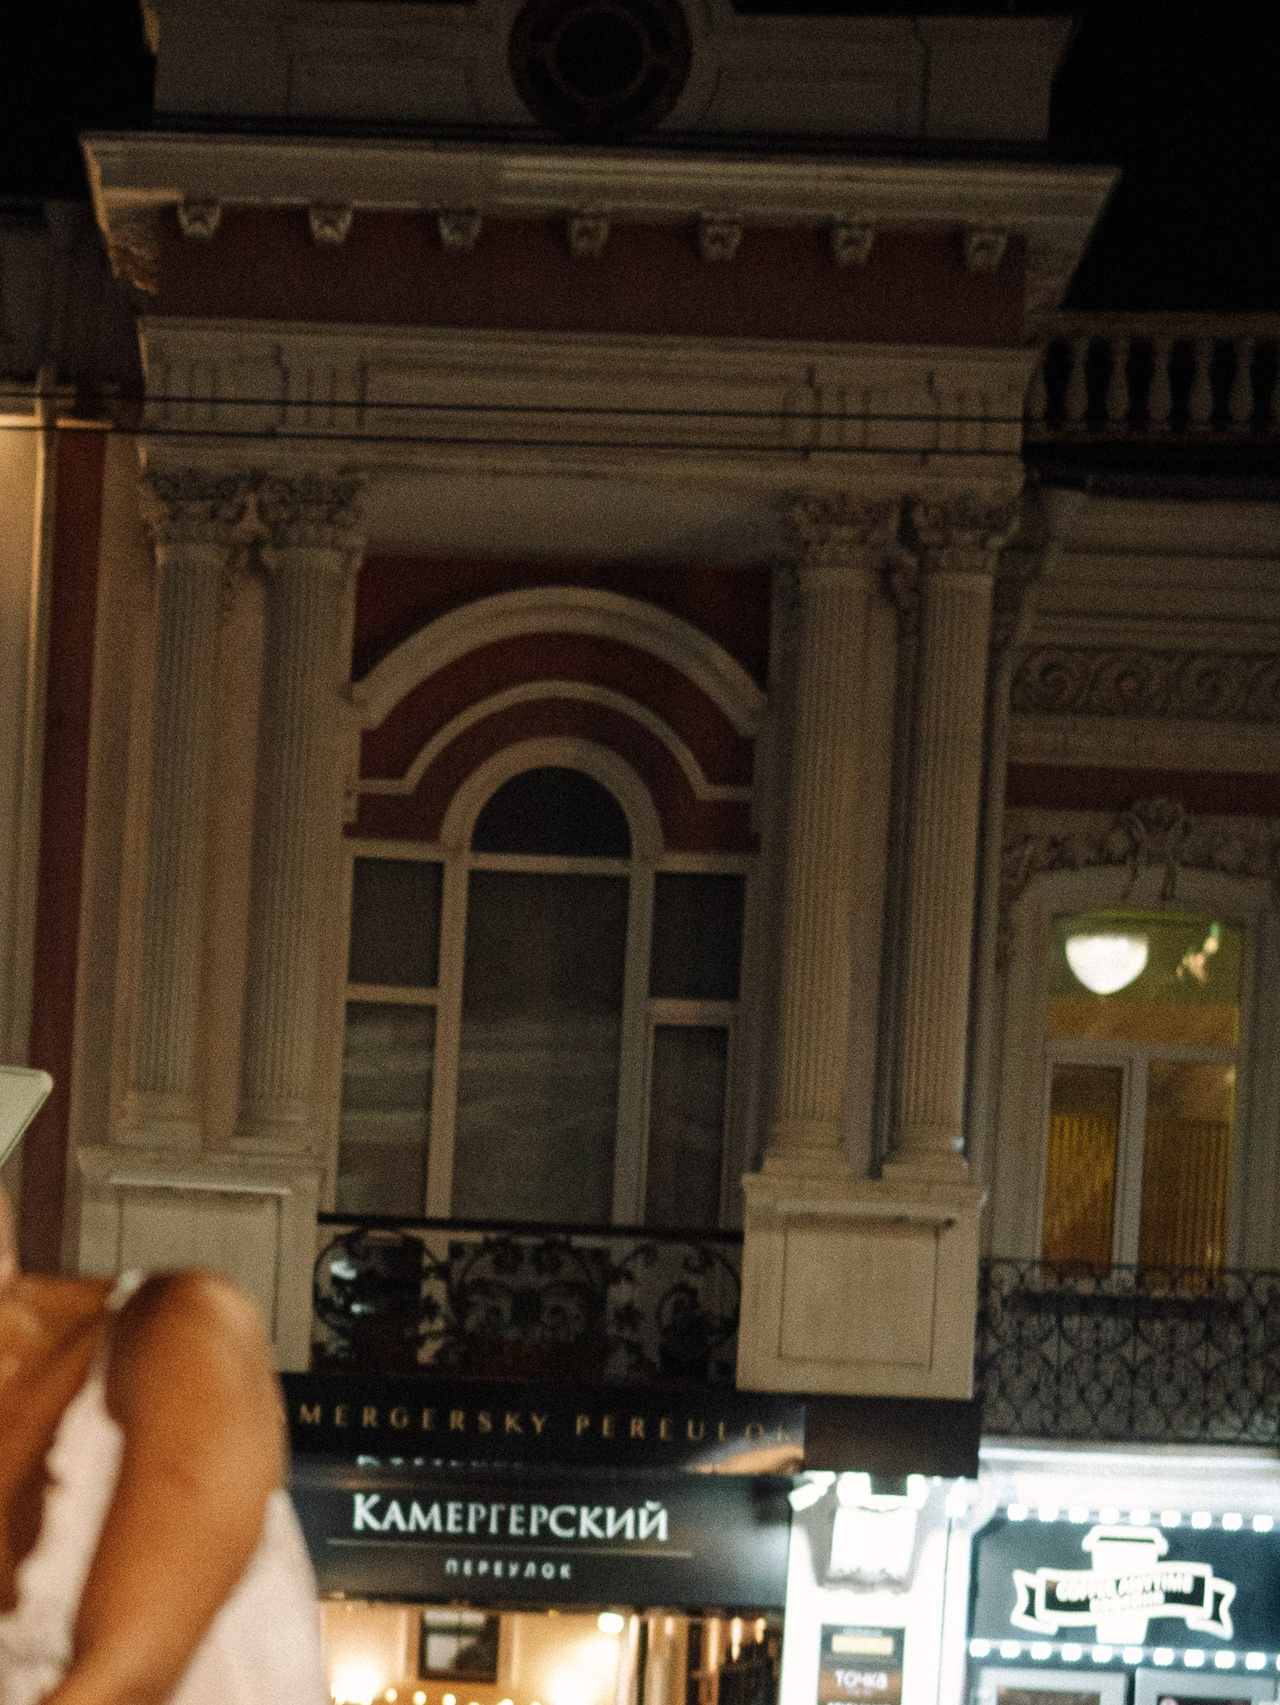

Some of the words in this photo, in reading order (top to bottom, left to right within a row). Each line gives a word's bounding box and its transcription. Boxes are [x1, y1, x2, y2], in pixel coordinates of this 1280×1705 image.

[299, 1403, 550, 1435] MERGERSKY
[352, 1493, 670, 1542] КАМЕРГЕРСКИЙ
[445, 1559, 573, 1580] ПЕРЕУЛОК
